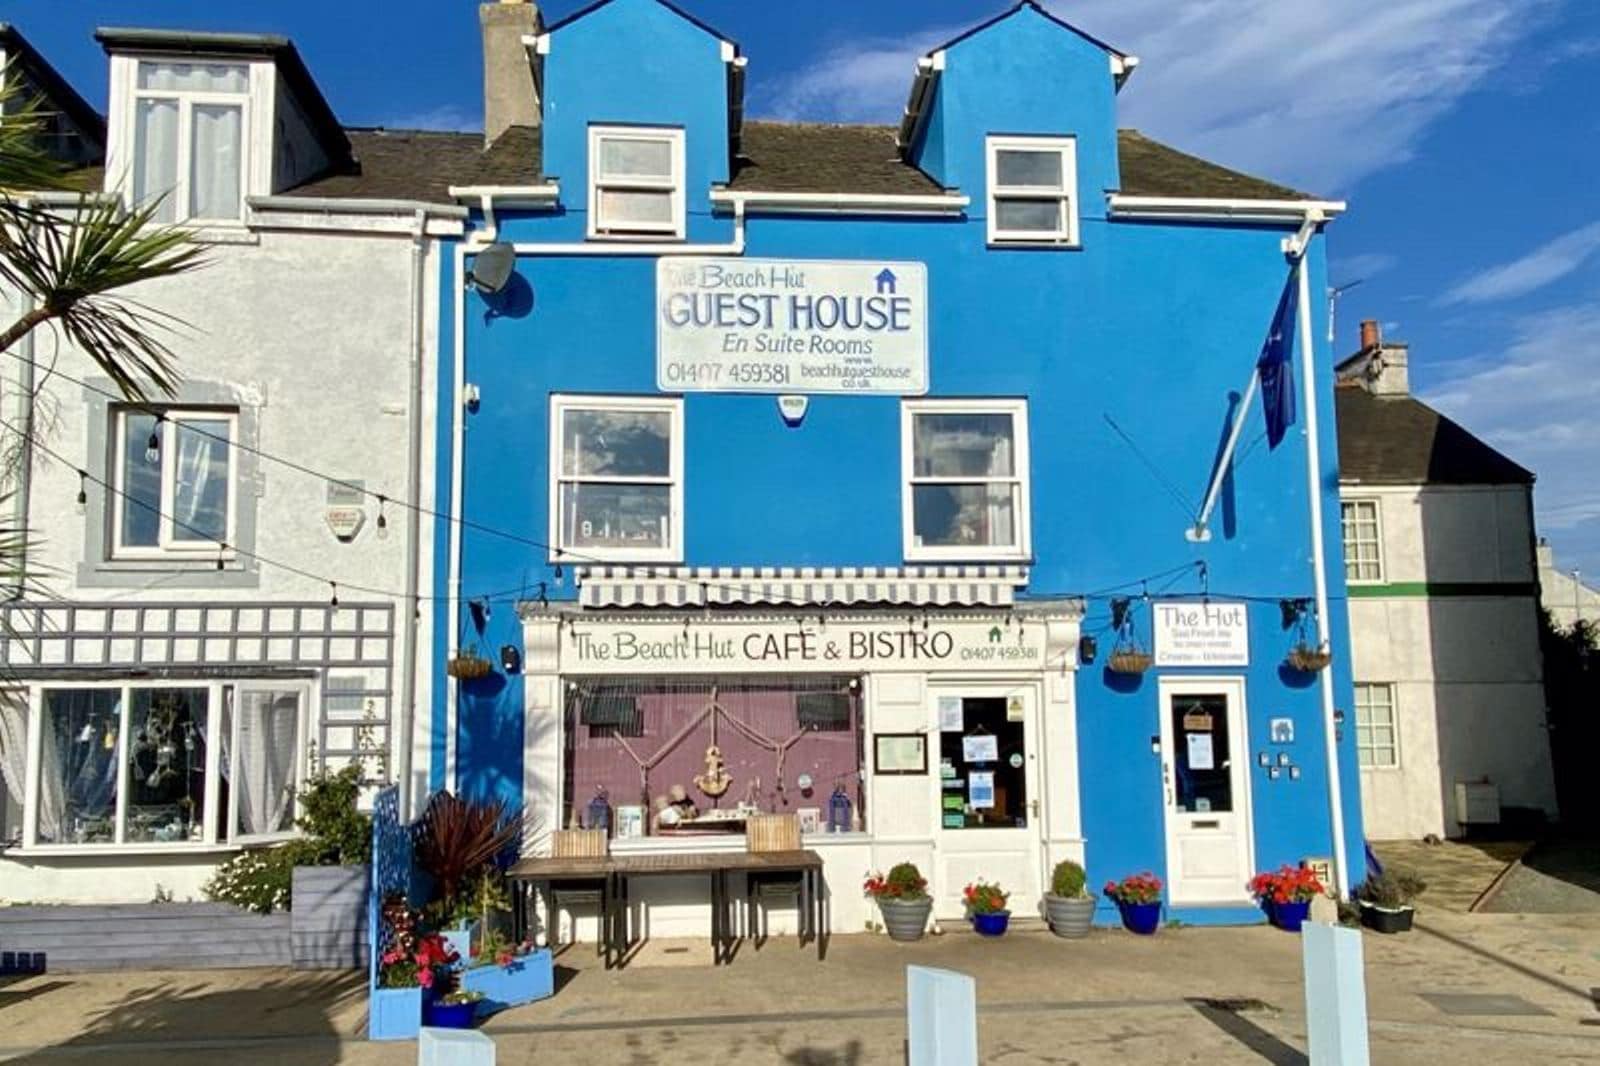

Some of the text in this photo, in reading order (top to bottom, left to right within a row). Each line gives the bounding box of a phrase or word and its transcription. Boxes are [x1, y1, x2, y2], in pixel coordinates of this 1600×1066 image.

[698, 265, 766, 288] Beach
[771, 266, 805, 289] Hut
[663, 292, 911, 332] GUEST HOUSE
[722, 333, 873, 354] En Suite Rooms
[667, 362, 791, 384] 01407 459381
[1158, 606, 1243, 627] The Hut
[574, 628, 954, 660] The Beach Hut CAFÉ & BISTRO
